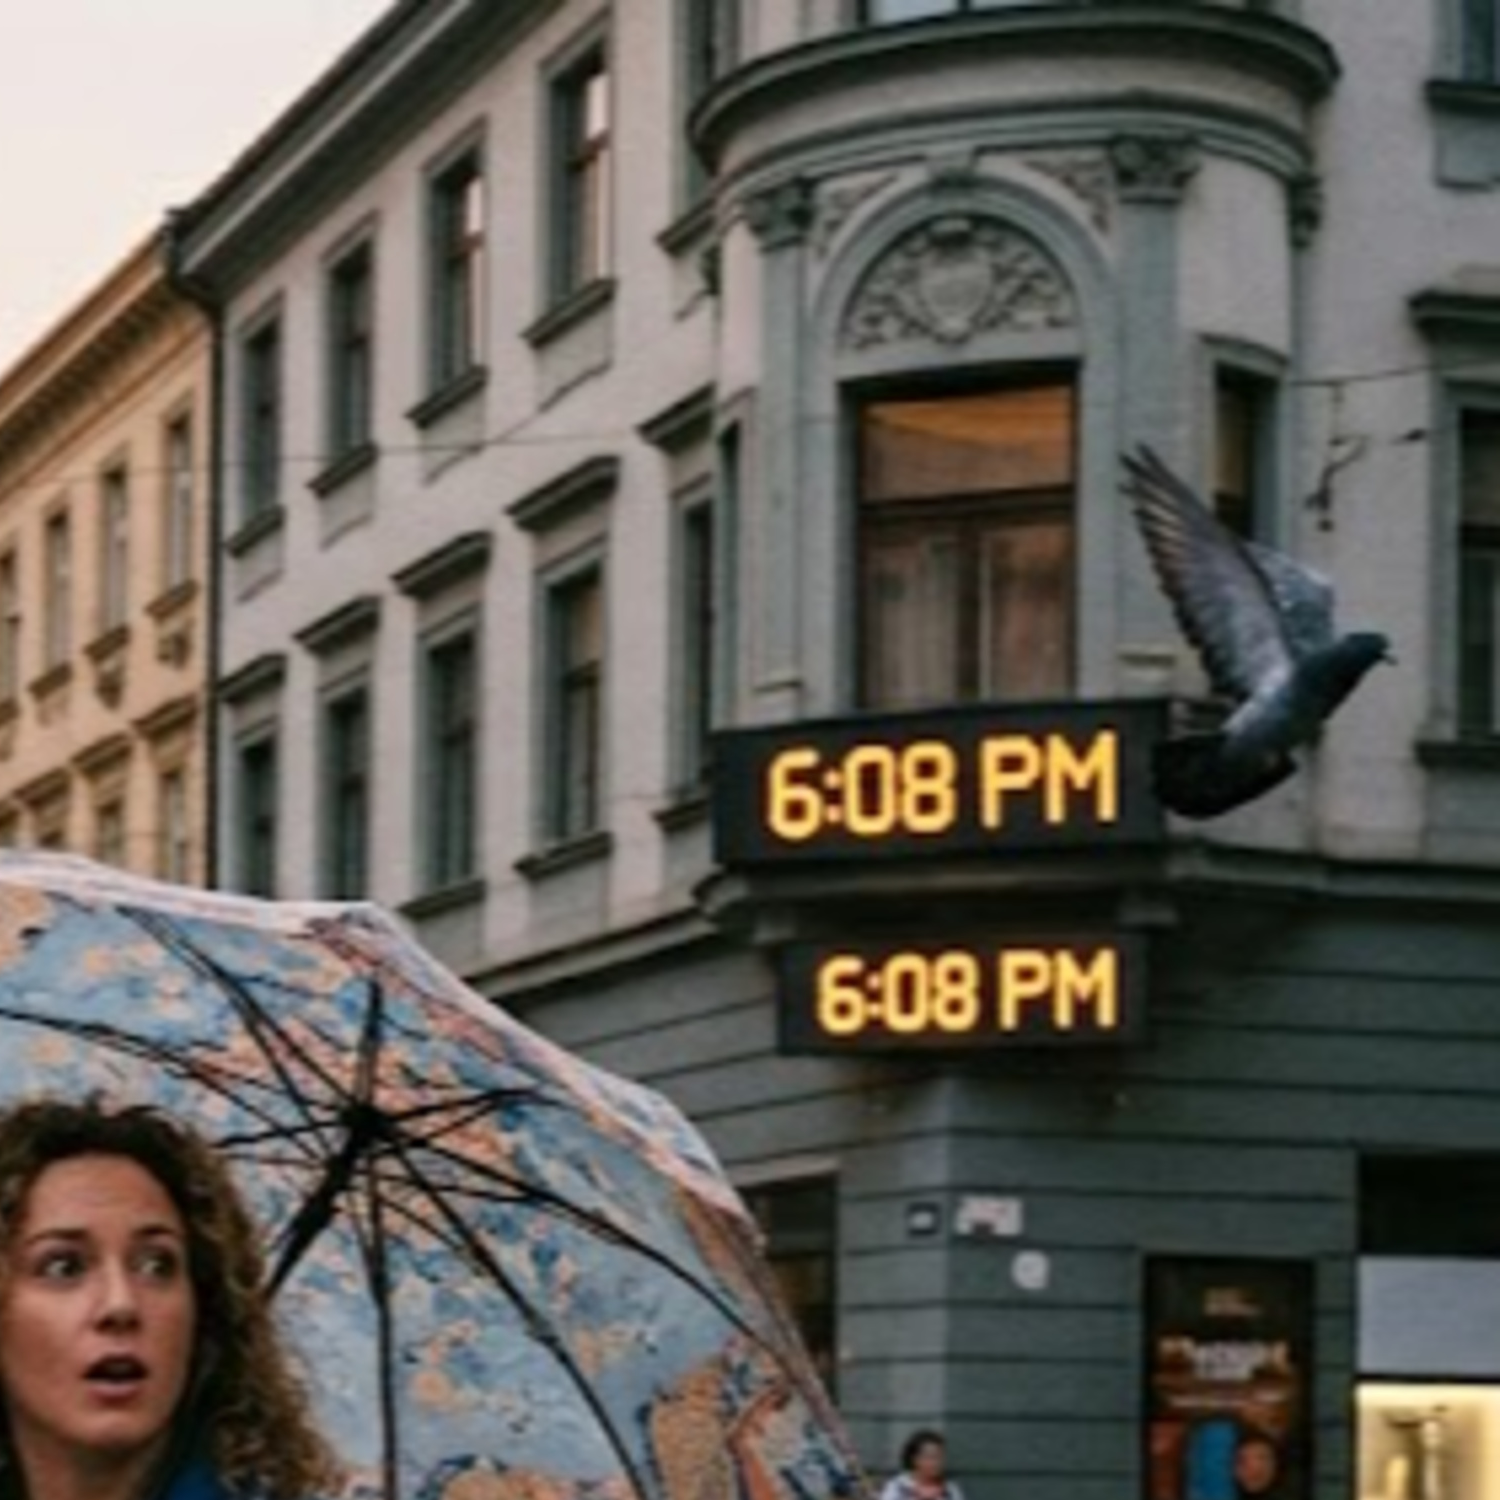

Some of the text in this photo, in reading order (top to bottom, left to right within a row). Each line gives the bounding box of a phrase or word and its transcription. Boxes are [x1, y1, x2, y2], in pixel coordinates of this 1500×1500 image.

[766, 730, 1118, 840] 6:08 PM
[817, 948, 1117, 1035] 6:08 PM
